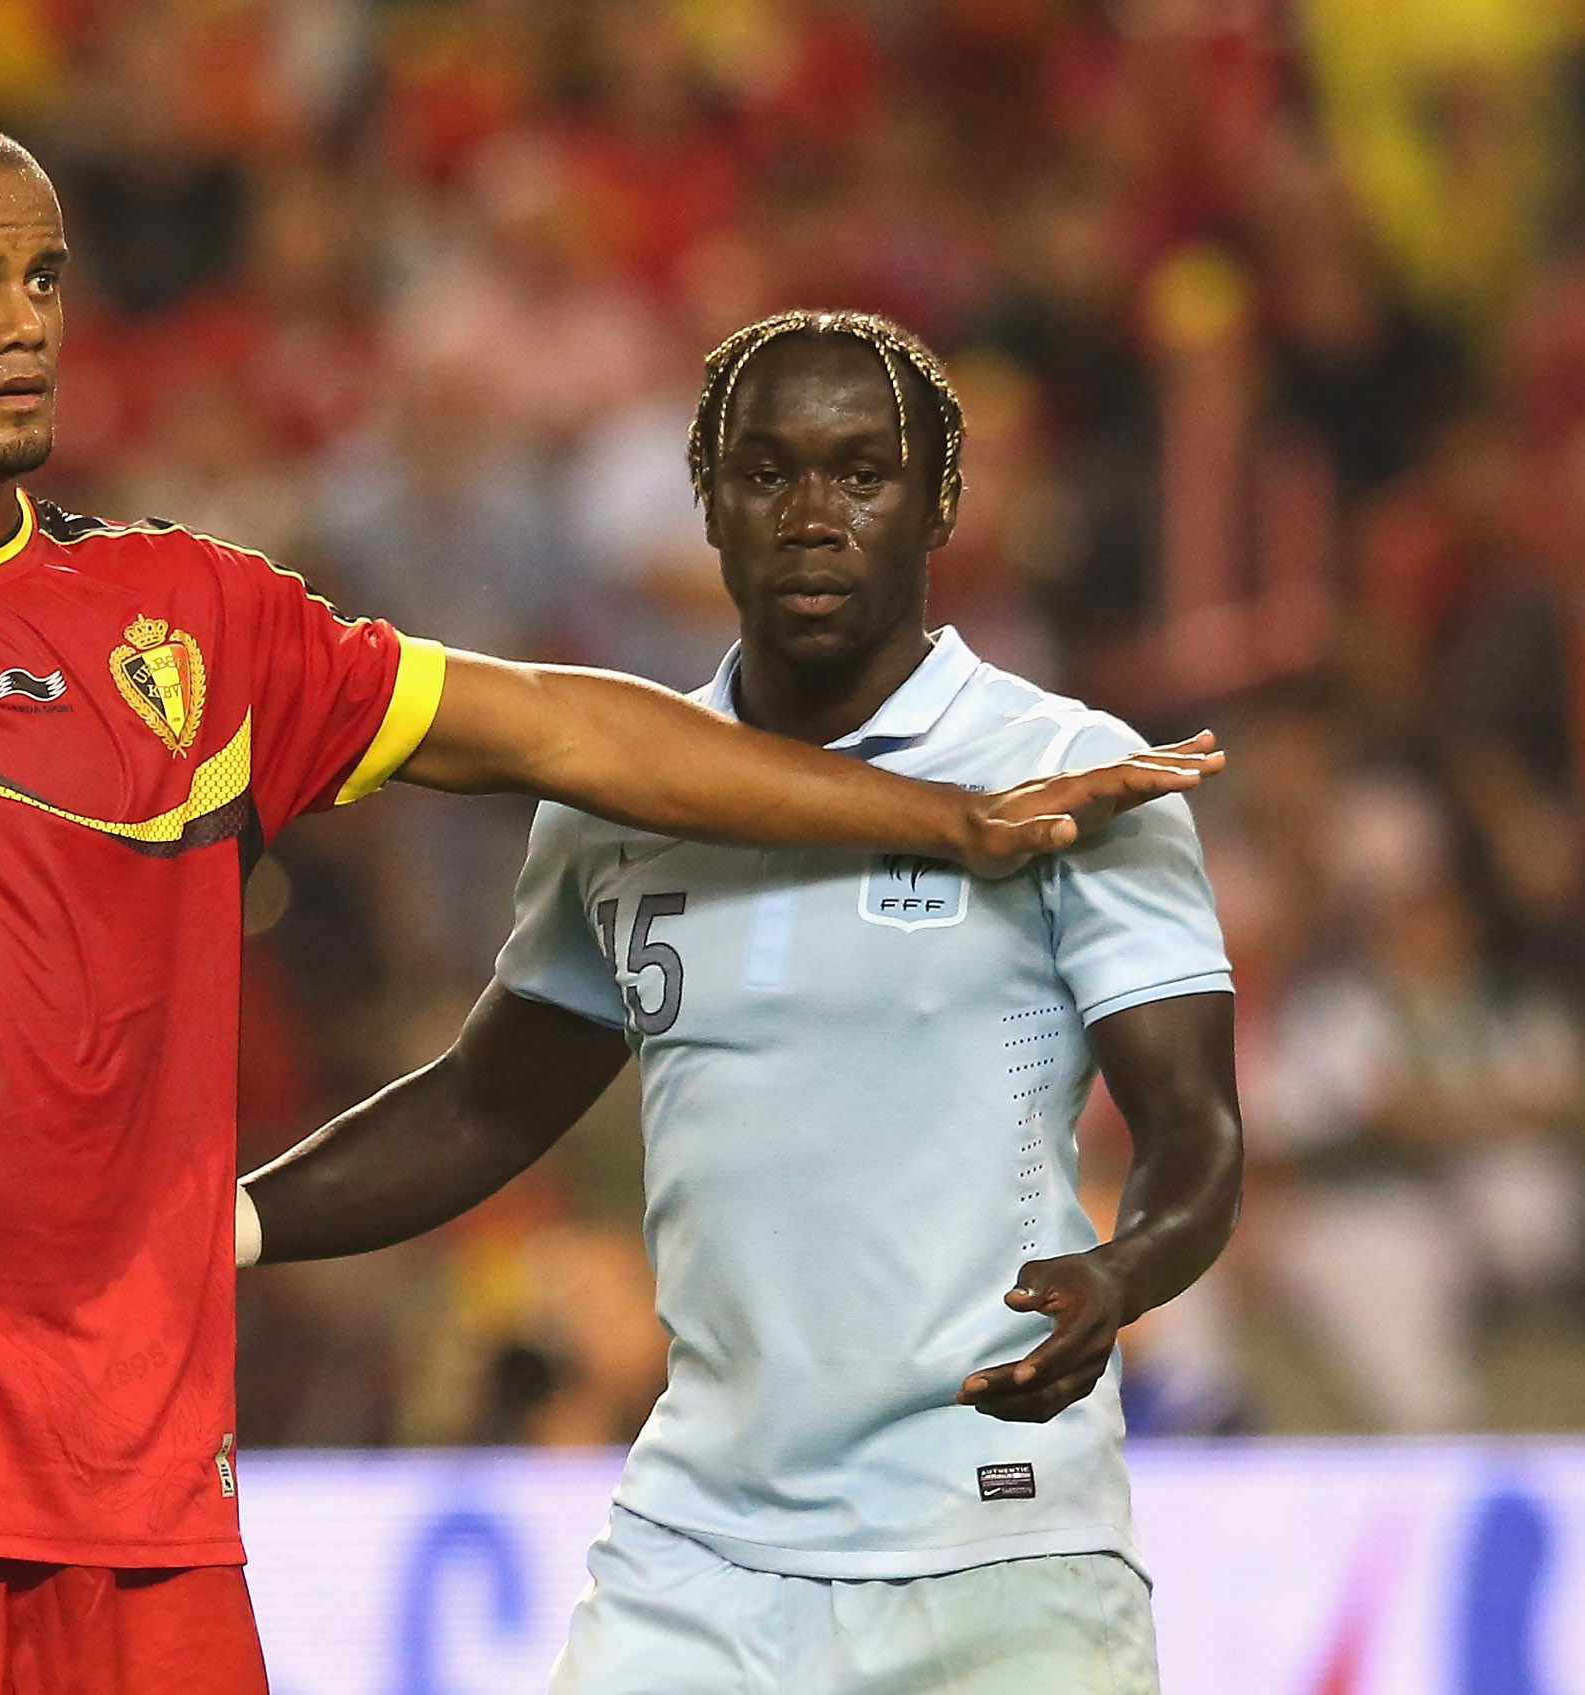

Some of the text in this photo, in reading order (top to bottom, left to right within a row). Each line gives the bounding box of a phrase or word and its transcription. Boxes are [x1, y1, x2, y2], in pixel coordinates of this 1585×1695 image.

[147, 682, 188, 699] KBV
[880, 898, 945, 913] FFF
[598, 893, 686, 1034] 15
[981, 1466, 1031, 1476] AUTHENTIC
